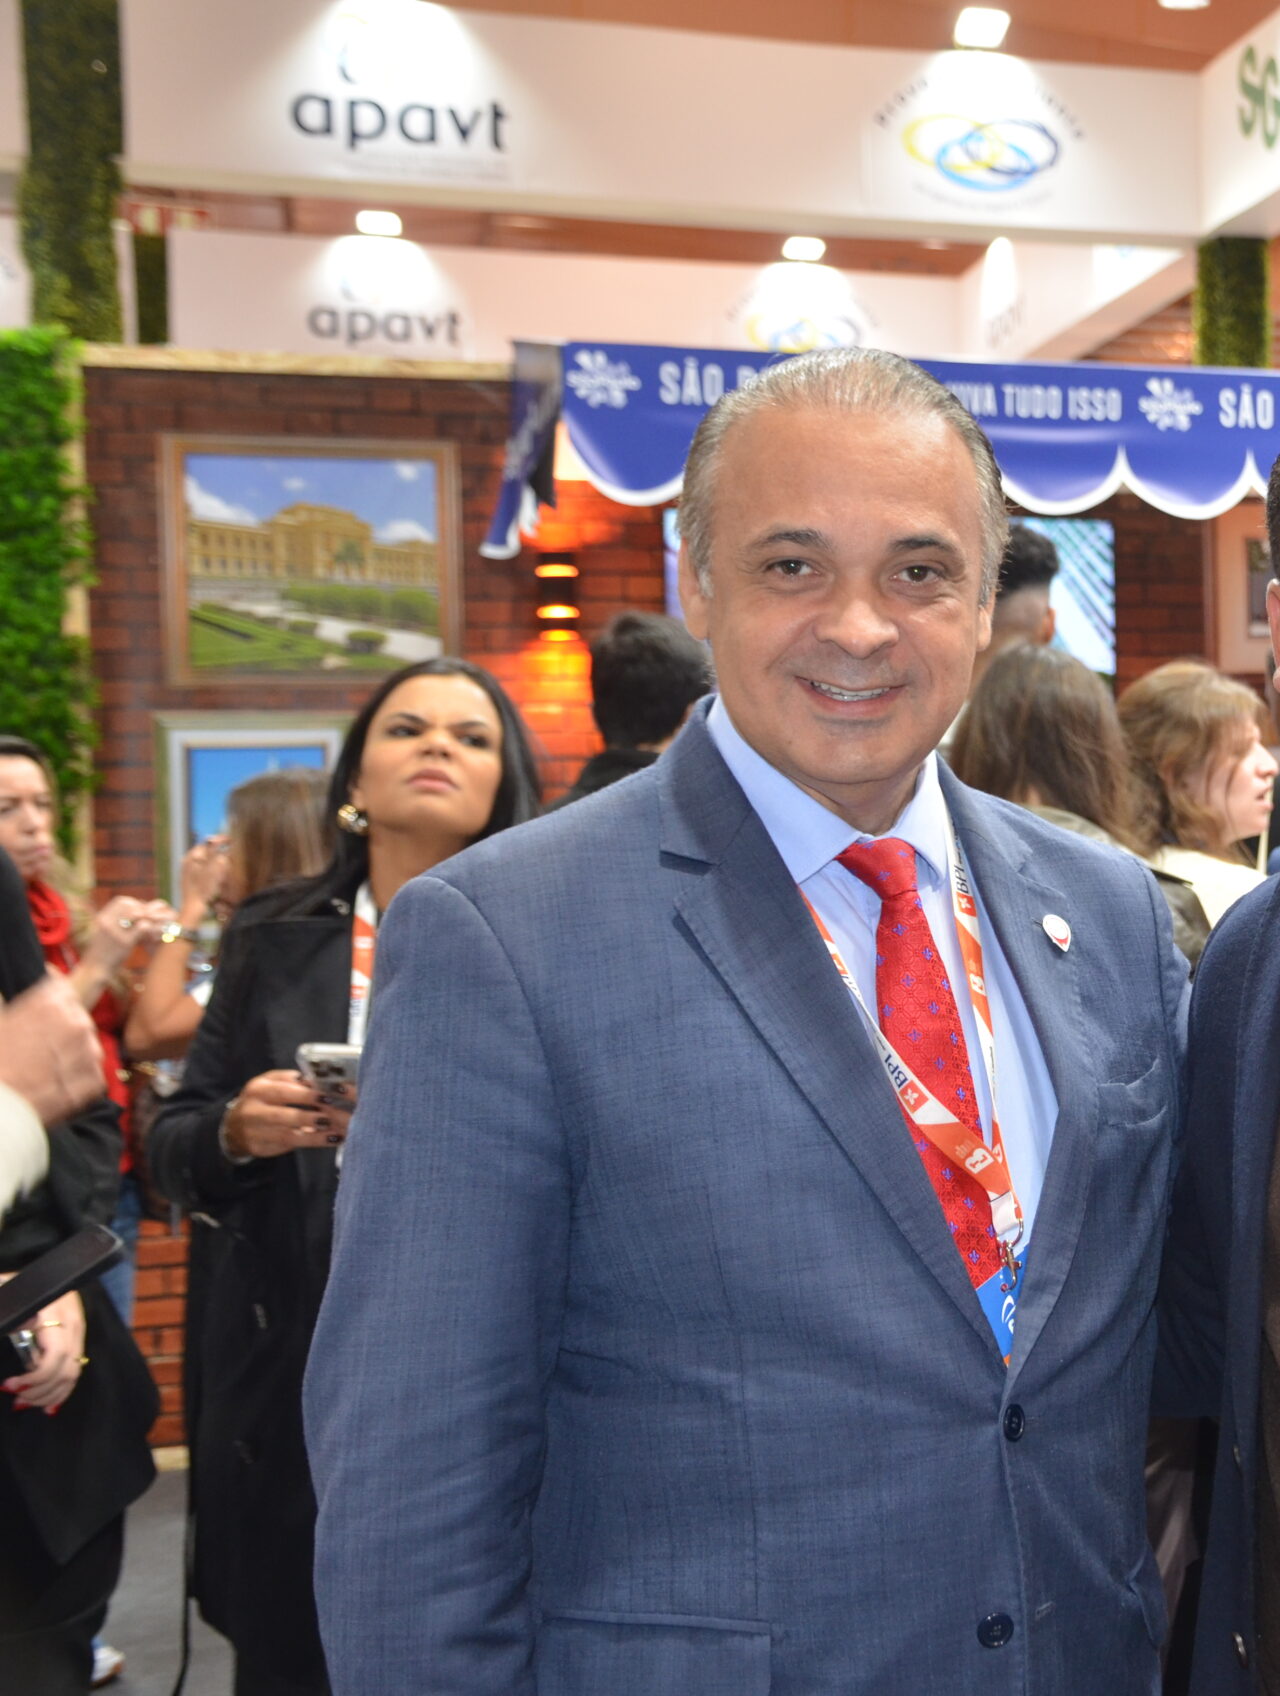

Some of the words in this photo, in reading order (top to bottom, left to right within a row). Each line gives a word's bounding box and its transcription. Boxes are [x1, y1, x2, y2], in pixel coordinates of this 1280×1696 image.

[291, 92, 507, 151] apavt
[307, 306, 460, 346] apavt
[659, 357, 725, 405] SÃO
[1002, 384, 1062, 420] TUDO
[1068, 387, 1122, 422] ISSO
[1218, 384, 1275, 430] SÃO
[955, 866, 970, 894] BPI
[884, 1054, 909, 1089] BPI
